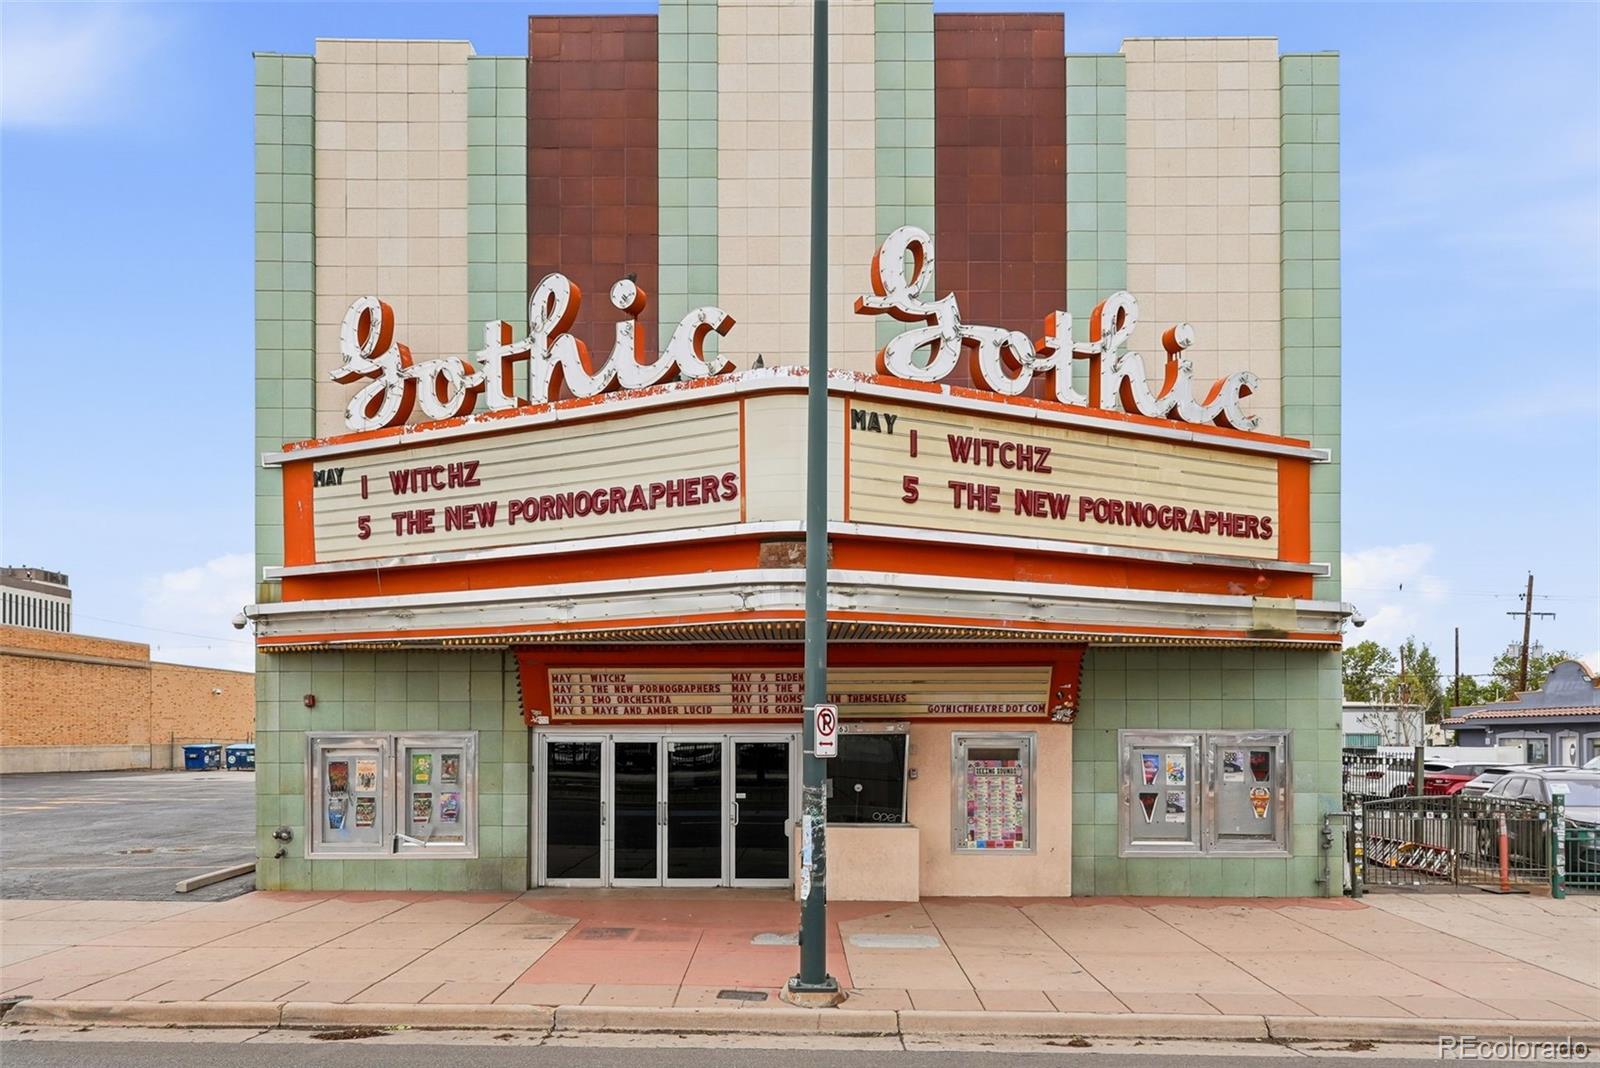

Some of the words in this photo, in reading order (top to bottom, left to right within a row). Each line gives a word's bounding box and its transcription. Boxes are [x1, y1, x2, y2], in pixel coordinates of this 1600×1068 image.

[854, 225, 1261, 431] Gothic
[329, 273, 736, 432] Gothic
[850, 408, 898, 434] MAY
[947, 434, 1052, 474] WITCHZ
[314, 468, 344, 488] MAY
[389, 460, 480, 495] WITCHZ
[358, 516, 371, 540] 5
[392, 508, 435, 536] THE
[444, 501, 498, 532] NEW
[508, 472, 738, 525] PORNOGRAPHERS
[902, 475, 919, 504] 5
[948, 480, 1000, 513] THE
[1014, 488, 1070, 520] NEW
[1079, 496, 1272, 540] PORNOGRAPHERS
[552, 674, 571, 683] MAY
[590, 674, 626, 682] WITCHZ
[732, 673, 750, 682] MAY
[760, 673, 766, 682] 9
[552, 684, 572, 694] MAY
[579, 684, 584, 694] 5
[591, 684, 608, 693] THE
[614, 684, 633, 693] NEW
[640, 684, 721, 693] PORNOGRAPHERS
[732, 684, 750, 692] MAY
[758, 684, 768, 692] 14
[776, 684, 792, 692] THE
[554, 696, 572, 704] MAY
[592, 696, 611, 704] EMO
[618, 695, 671, 704] ORCHESTRA
[732, 694, 750, 704] MAY
[758, 694, 768, 703] 15
[776, 694, 802, 703] MOMS
[847, 694, 906, 703] THEMSELVES
[554, 706, 574, 715] MAY
[580, 706, 586, 714] 8
[592, 706, 618, 715] MAYE
[624, 706, 642, 714] AND
[648, 706, 678, 714] AMBER
[684, 706, 712, 714] LUCID
[732, 706, 751, 714] MAY
[758, 705, 768, 714] 16
[928, 704, 1003, 713] GOTHICTHEATRE
[1006, 704, 1024, 713] DOT
[1026, 704, 1046, 712] COM
